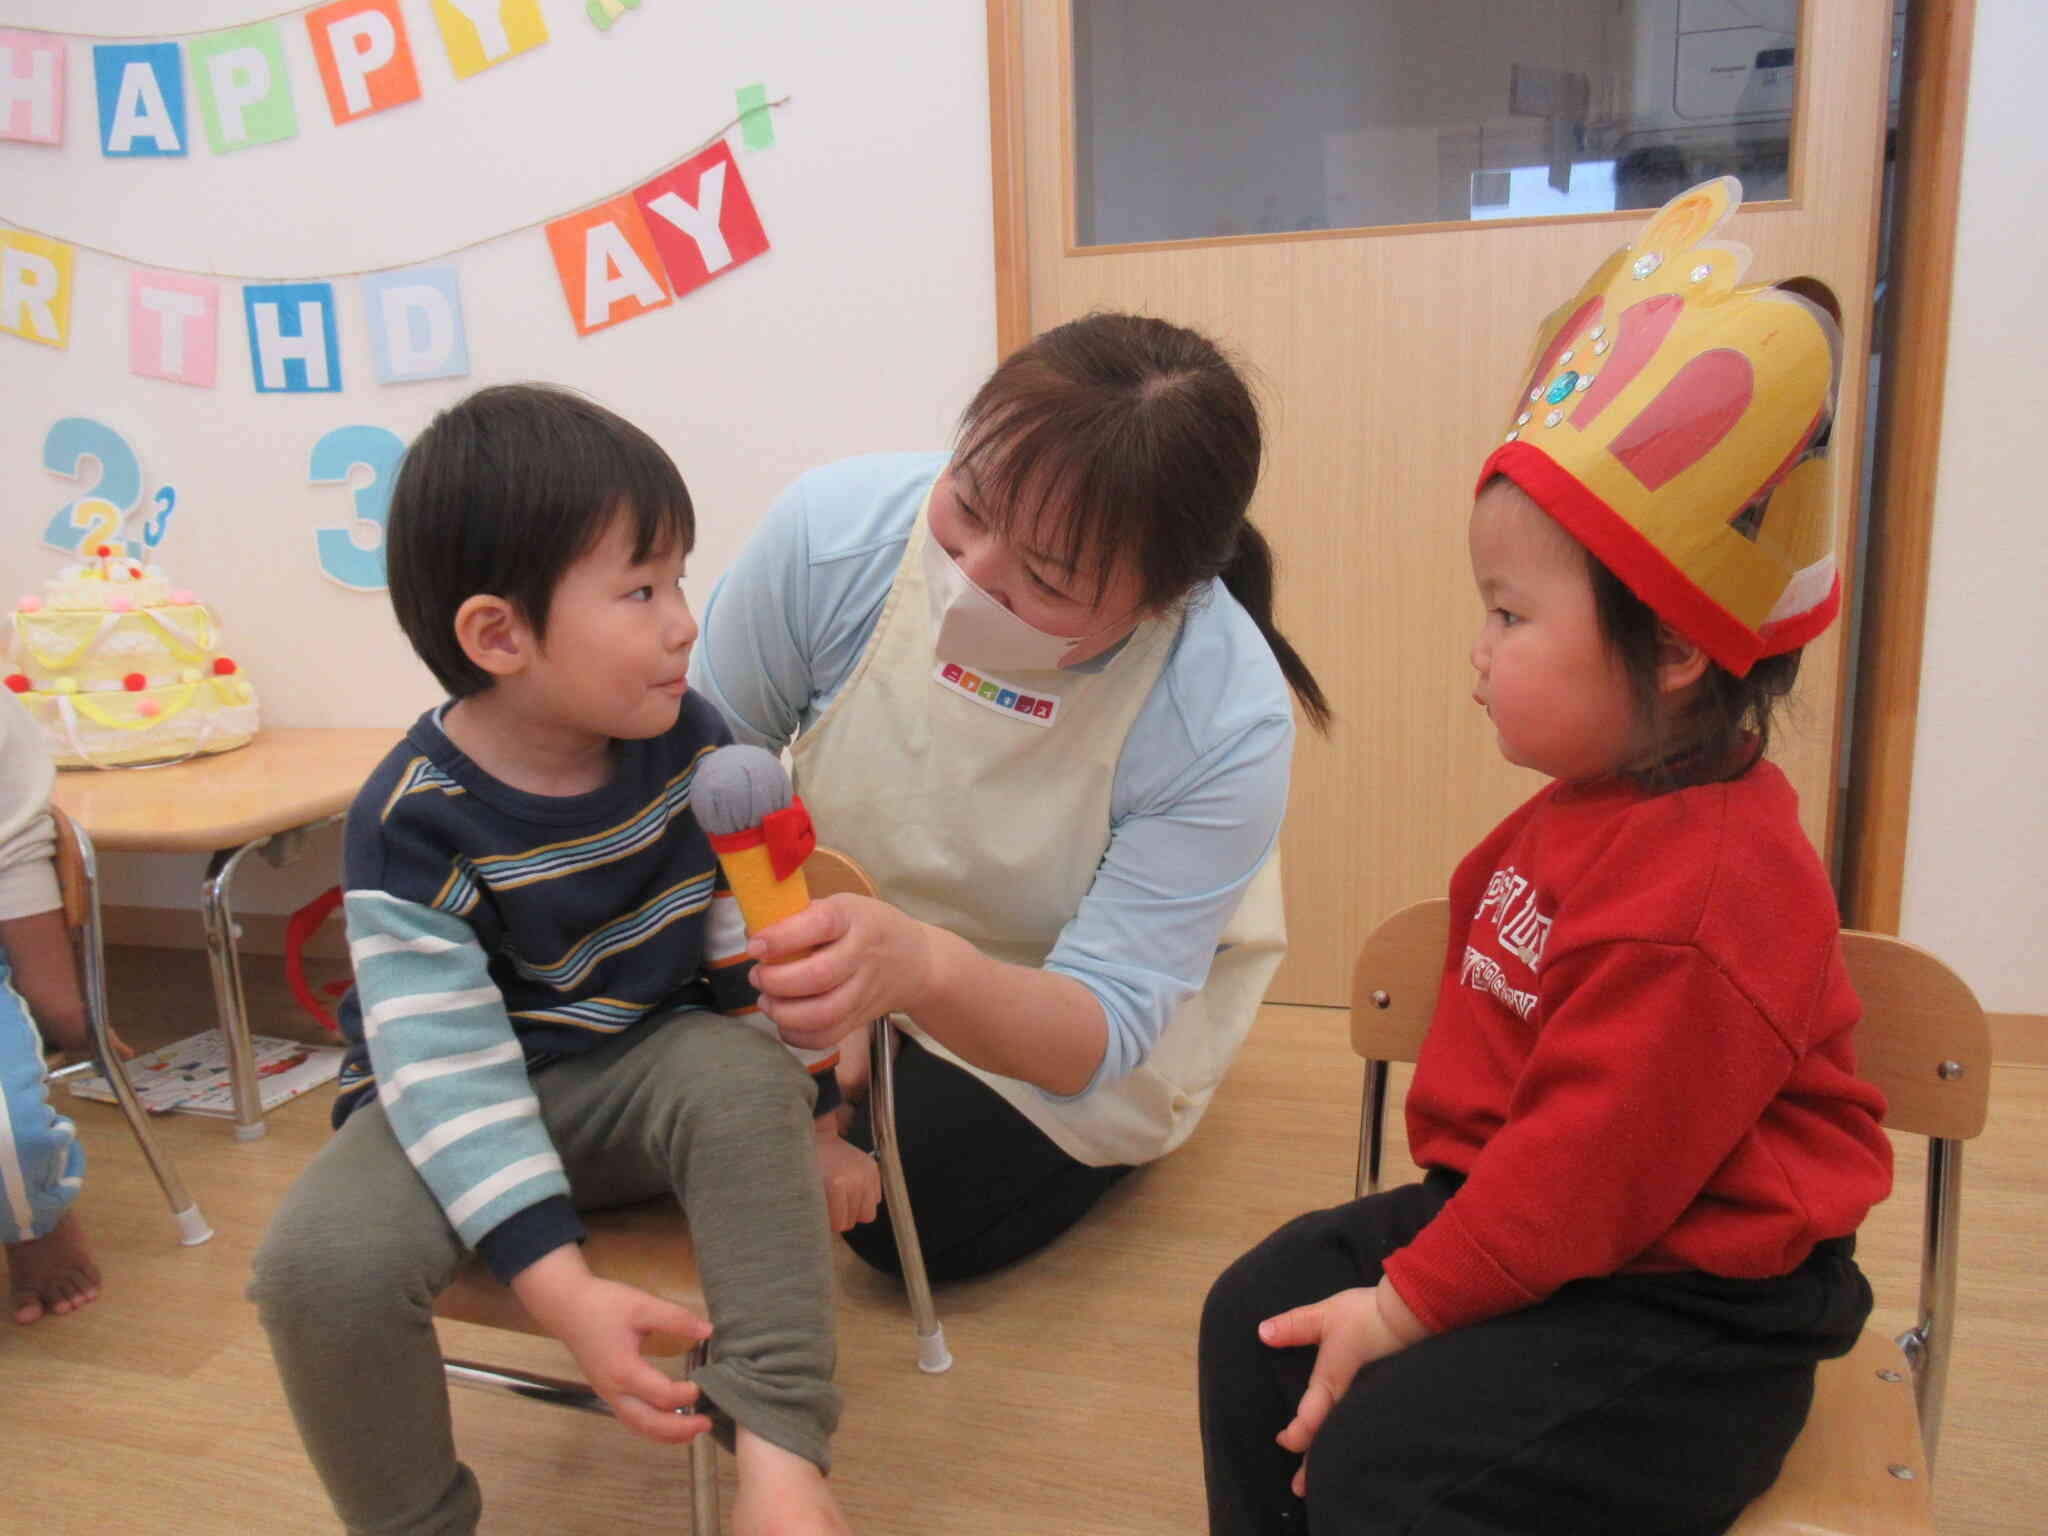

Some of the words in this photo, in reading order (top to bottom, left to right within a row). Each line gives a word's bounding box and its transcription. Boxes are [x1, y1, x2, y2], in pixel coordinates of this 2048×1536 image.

[0, 0, 511, 152] HAPPY
[74, 500, 126, 558] 2
[308, 424, 408, 589] 3
